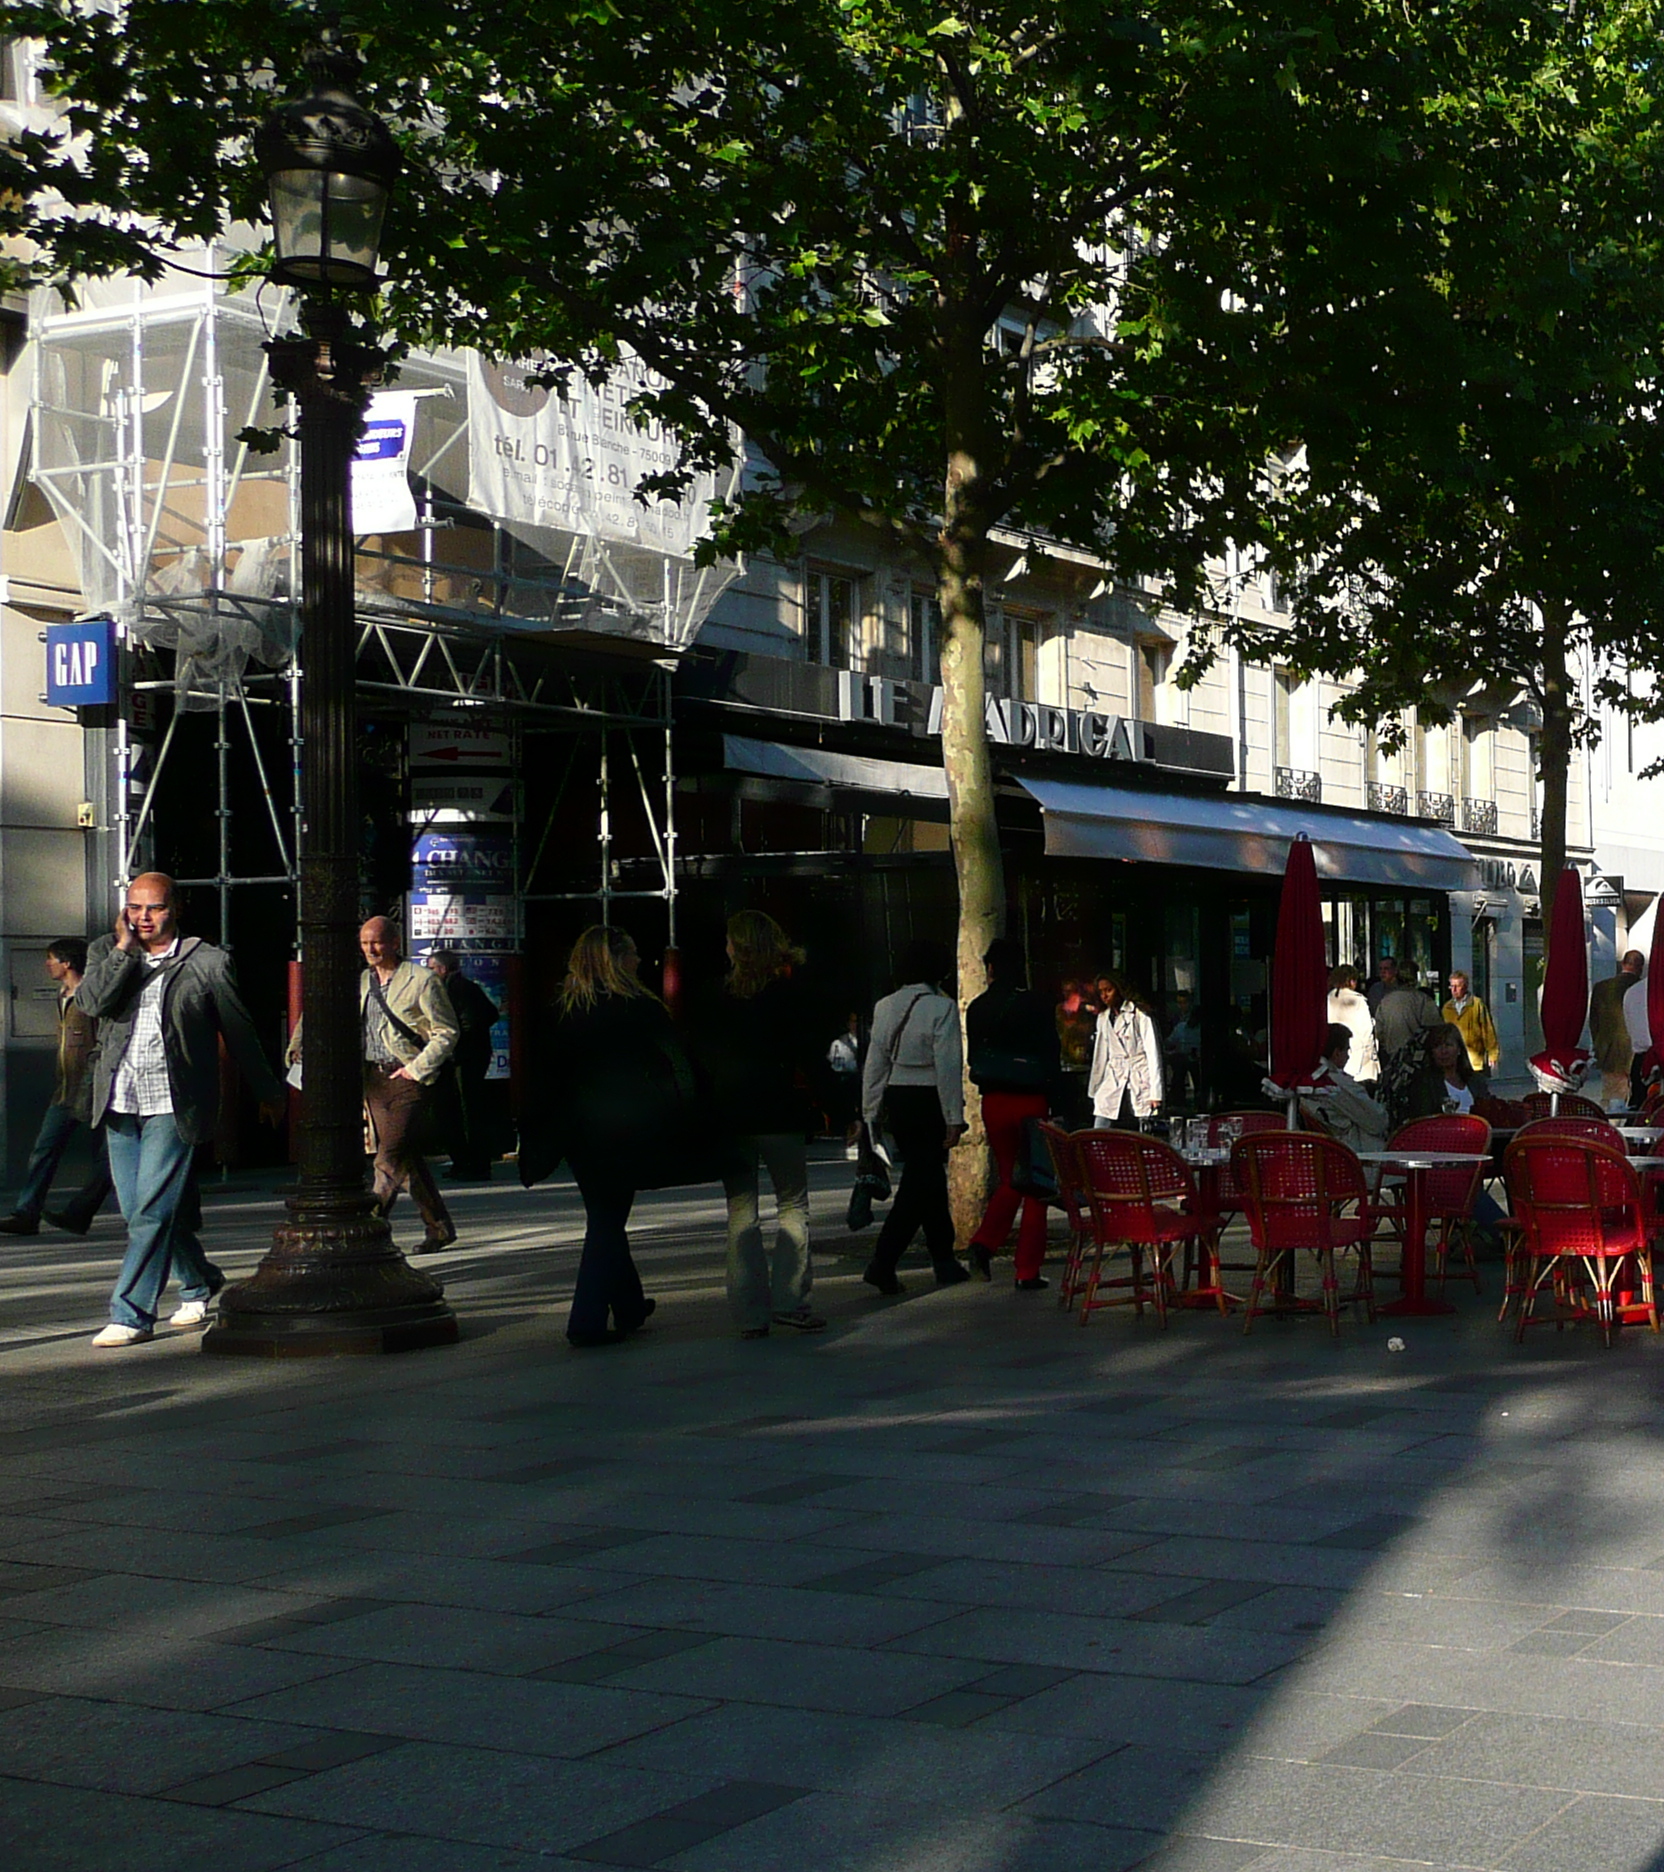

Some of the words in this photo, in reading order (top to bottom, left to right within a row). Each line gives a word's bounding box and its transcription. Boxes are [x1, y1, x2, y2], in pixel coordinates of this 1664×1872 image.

[494, 434, 526, 461] tél.
[592, 433, 630, 456] Banche
[55, 641, 97, 687] GAP
[838, 670, 908, 729] LE
[427, 850, 517, 869] CHANG
